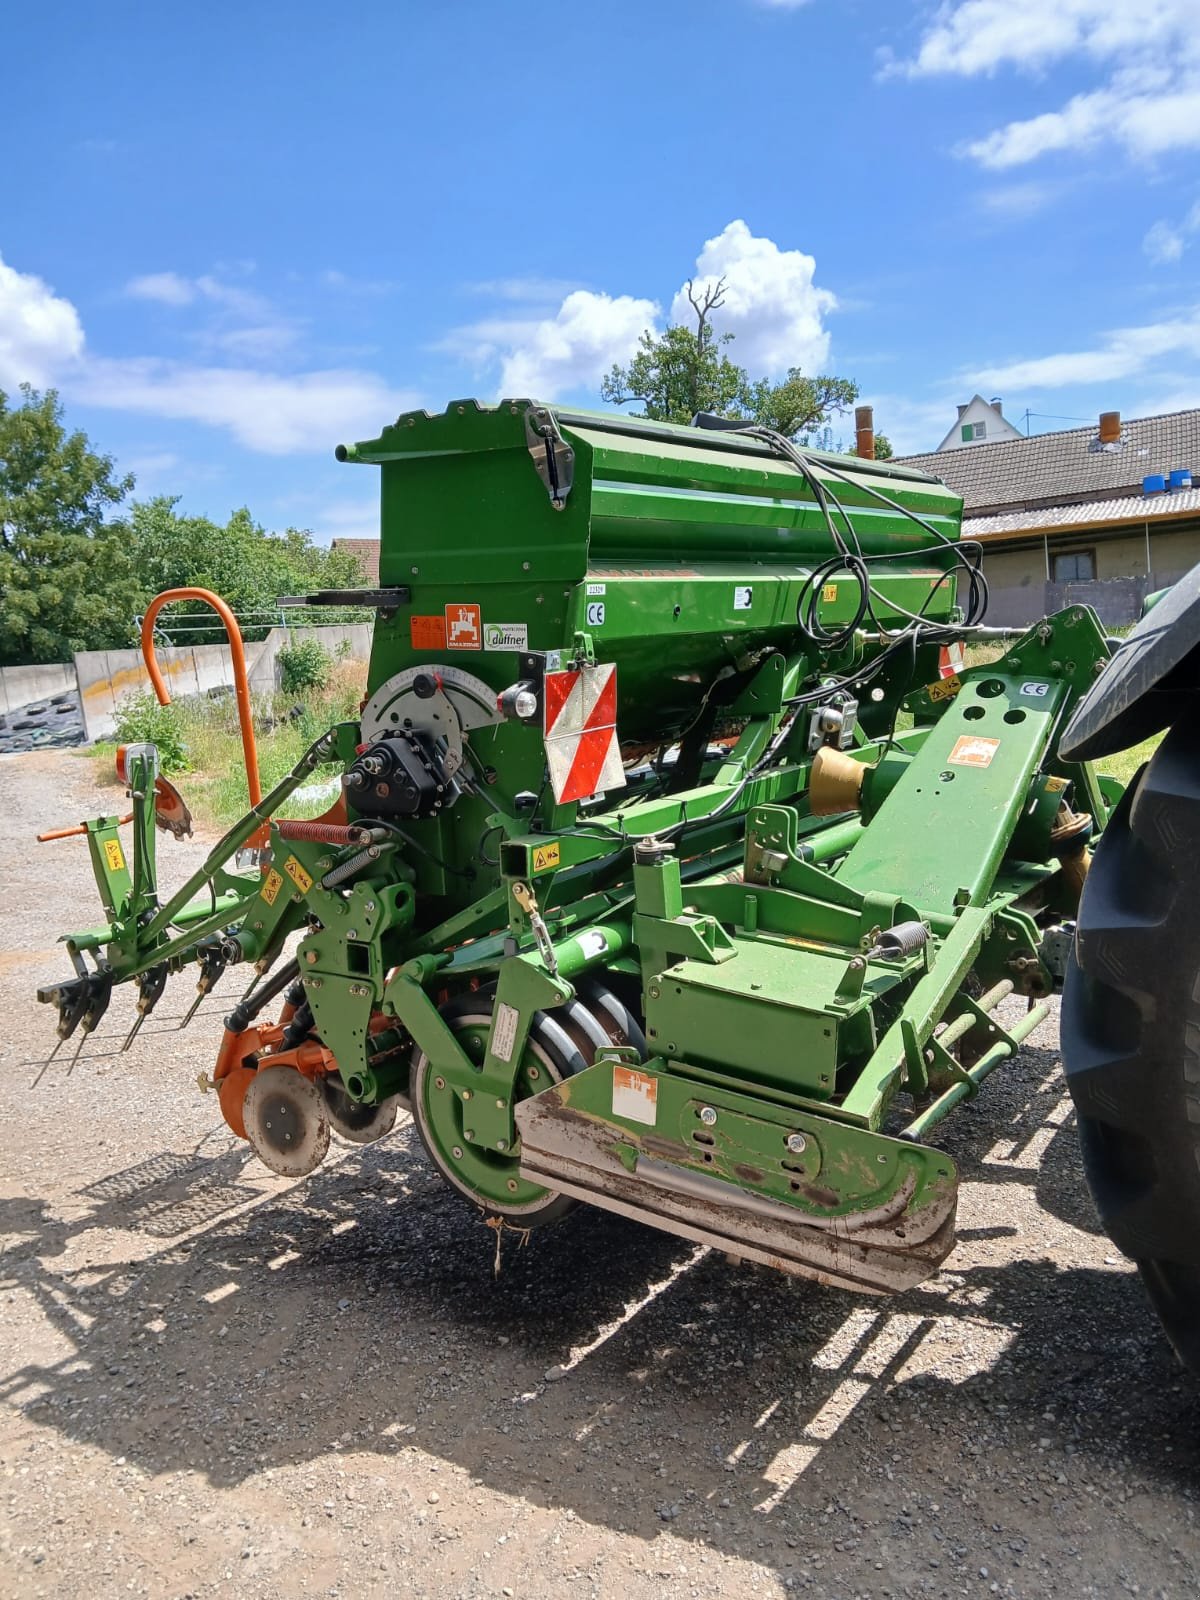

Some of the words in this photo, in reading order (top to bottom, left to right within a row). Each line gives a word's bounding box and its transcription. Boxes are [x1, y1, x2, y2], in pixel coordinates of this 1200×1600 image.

[588, 604, 603, 623] CE
[492, 633, 526, 645] duffner
[1023, 684, 1048, 695] CE
